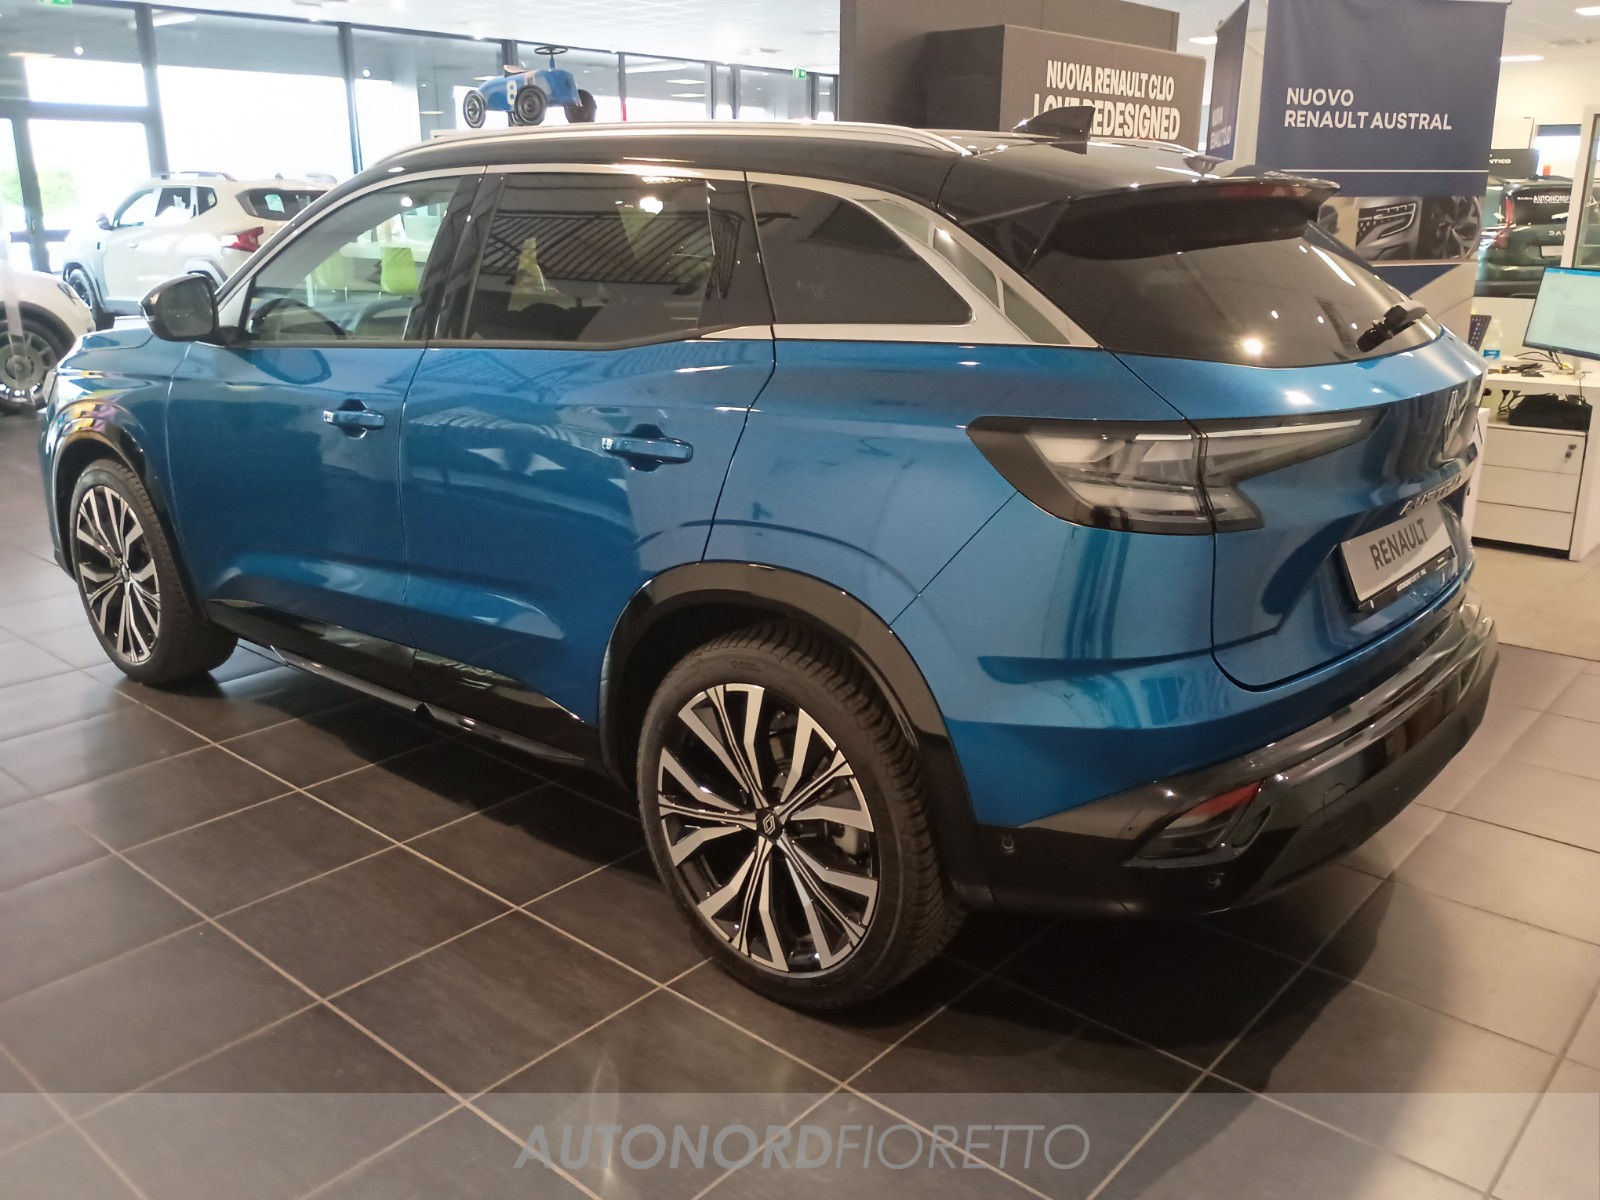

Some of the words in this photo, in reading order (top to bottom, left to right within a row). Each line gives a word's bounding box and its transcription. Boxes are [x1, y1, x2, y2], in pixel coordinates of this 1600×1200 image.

[1046, 60, 1093, 92] NUOVA
[1094, 66, 1149, 98] RENAULT
[1149, 74, 1175, 101] CLIO
[1286, 87, 1354, 107] NUOVO
[1284, 110, 1369, 129] RENAULT
[1370, 112, 1452, 130] AUSTRAL
[1369, 517, 1428, 570] RENAULT
